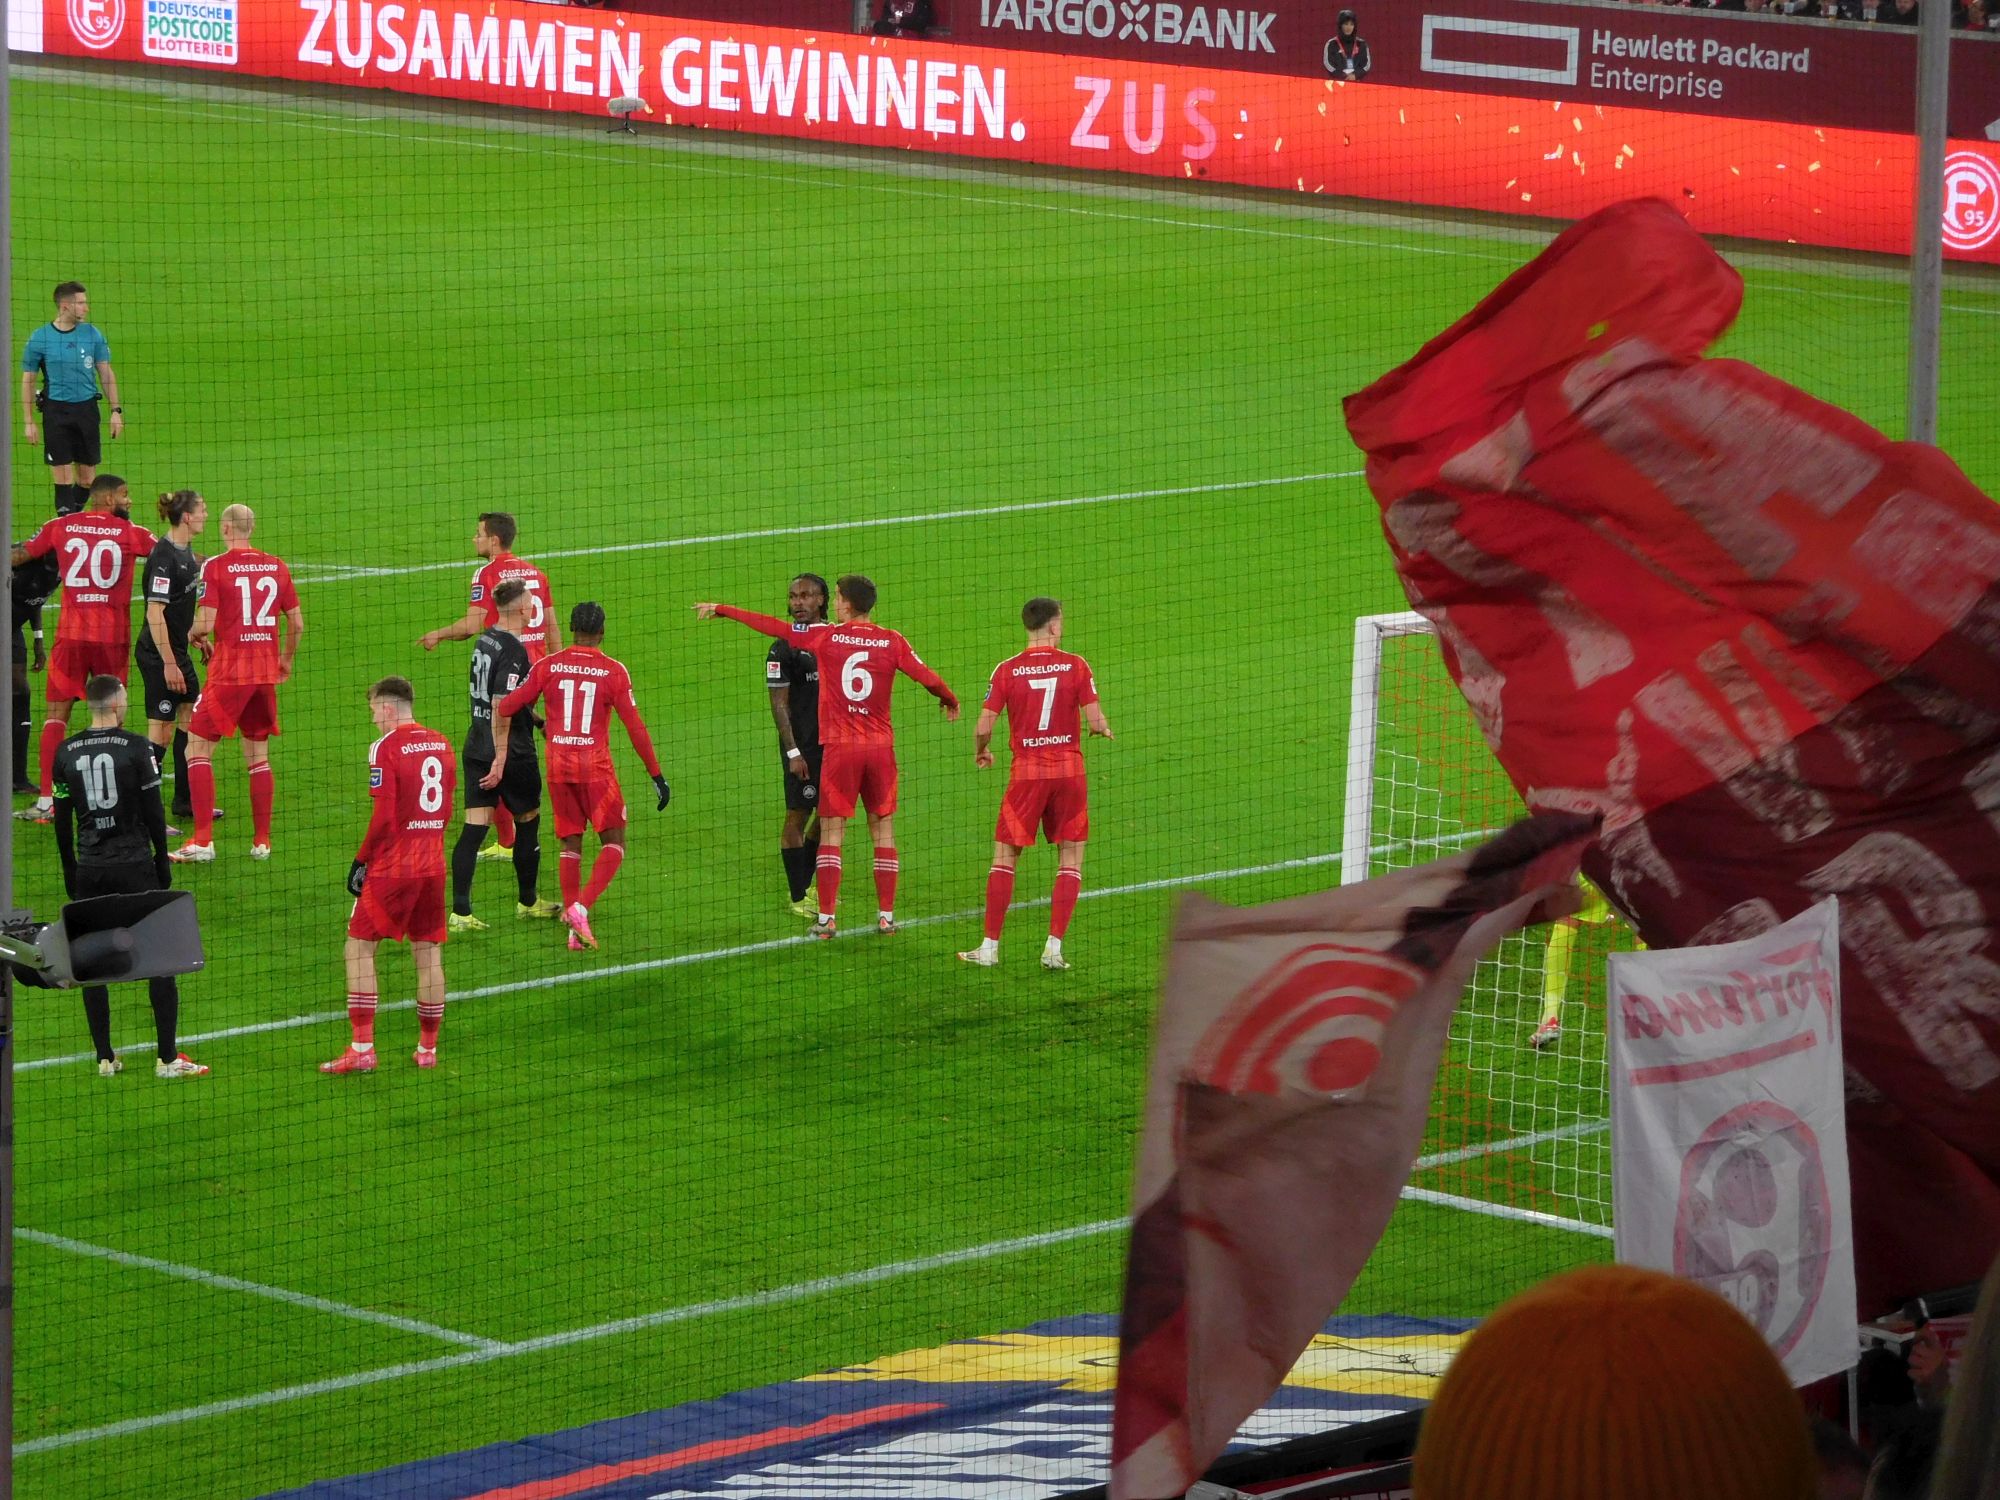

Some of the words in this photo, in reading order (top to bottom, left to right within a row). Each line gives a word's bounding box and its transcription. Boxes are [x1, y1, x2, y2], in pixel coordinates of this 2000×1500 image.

[95, 15, 111, 30] 95
[158, 2, 223, 20] DEUTSCHE
[148, 15, 233, 43] POSTCODE
[158, 38, 223, 56] LOTTERIE
[1592, 29, 1697, 63] Hewlett
[1702, 39, 1810, 73] Packard
[298, 0, 641, 98] ZUSAMMEN
[660, 36, 1026, 142] GEWINNEN.
[1070, 76, 1217, 160] ZUS
[1590, 62, 1723, 100] Enterprise
[1964, 210, 1985, 227] 95
[65, 523, 122, 536] DÜSSELDORF
[64, 537, 123, 589] 20
[227, 563, 279, 573] DÜSSELDORF
[234, 576, 278, 627] 12
[831, 633, 890, 648] DÜSSELDORF
[550, 662, 610, 677] DÜSSELDORF
[841, 651, 873, 702] 6
[1012, 663, 1073, 677] DÜSSELDORF
[558, 679, 597, 735] 11
[1027, 676, 1058, 731] 7
[75, 752, 119, 811] 10
[419, 756, 443, 813] 8
